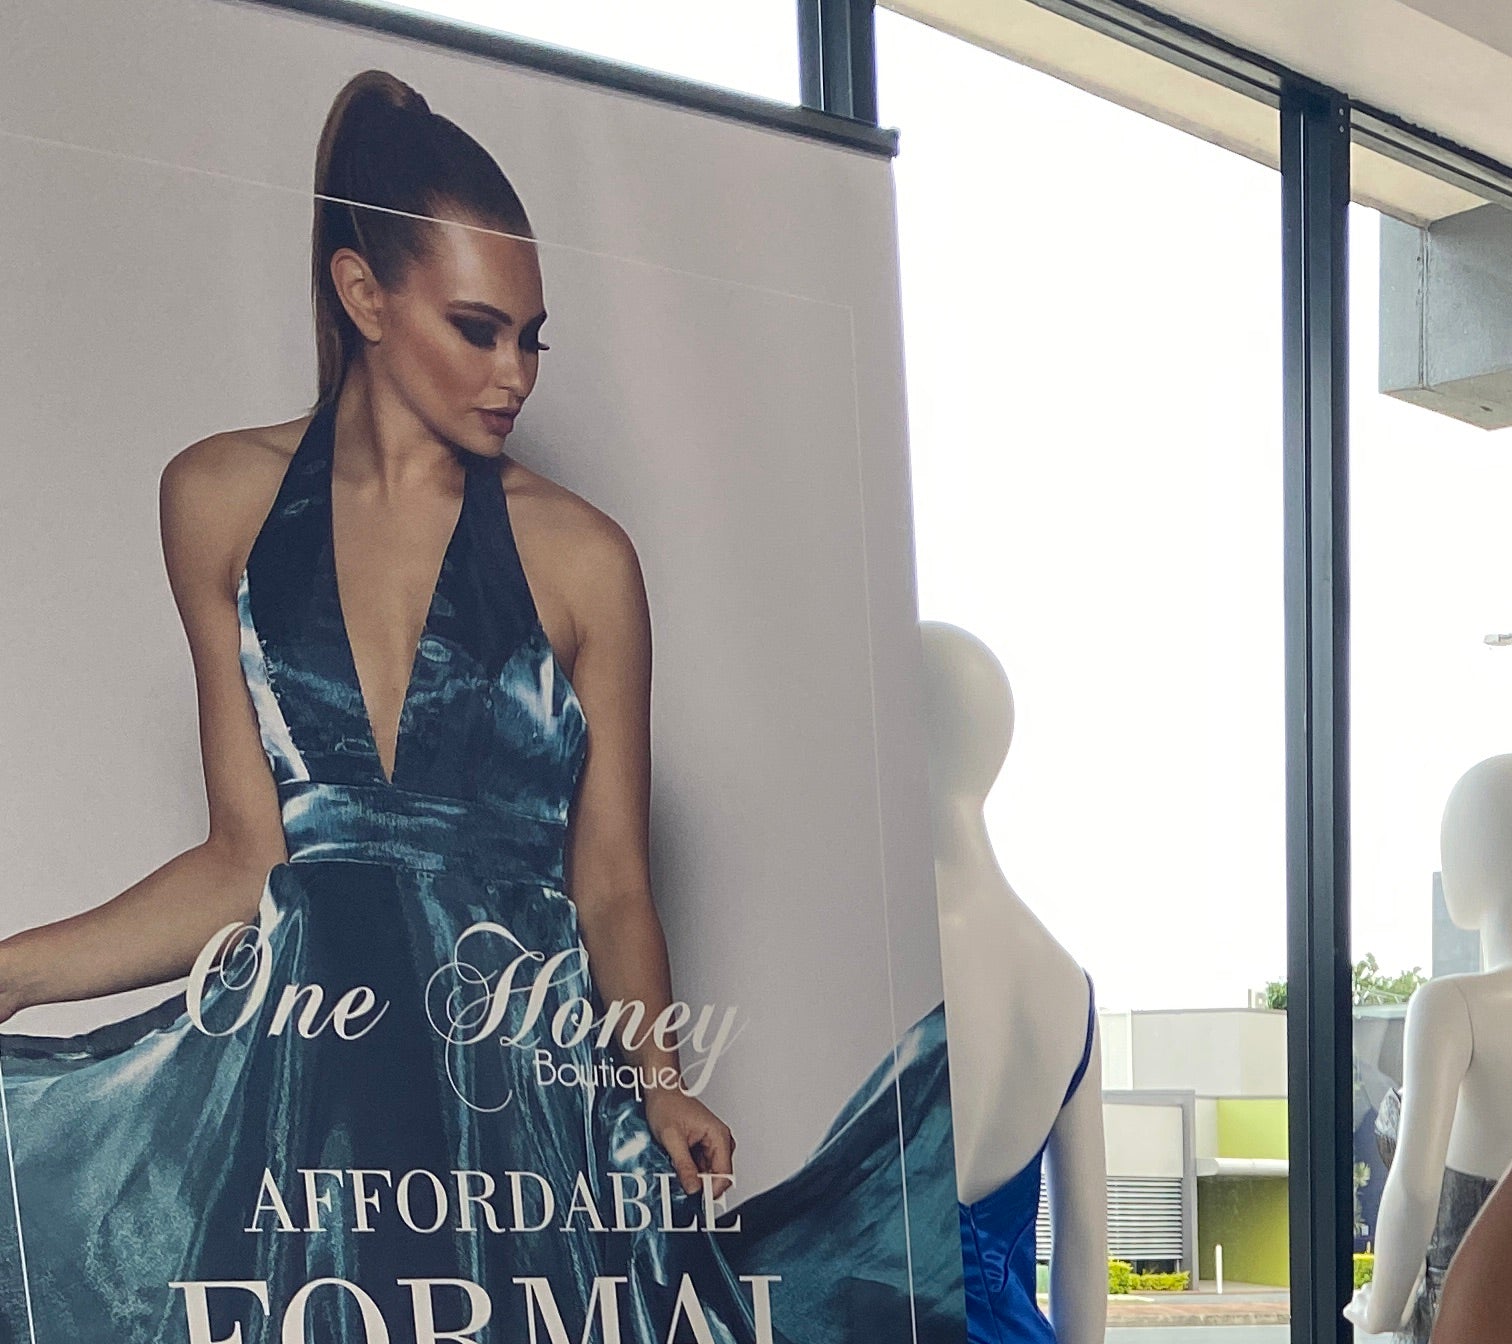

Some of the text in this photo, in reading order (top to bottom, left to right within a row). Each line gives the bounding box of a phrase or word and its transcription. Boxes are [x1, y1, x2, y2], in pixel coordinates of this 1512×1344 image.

[186, 921, 750, 1113] One Honey
[533, 1049, 680, 1102] Boutique
[244, 1167, 742, 1234] AFFORDABLE
